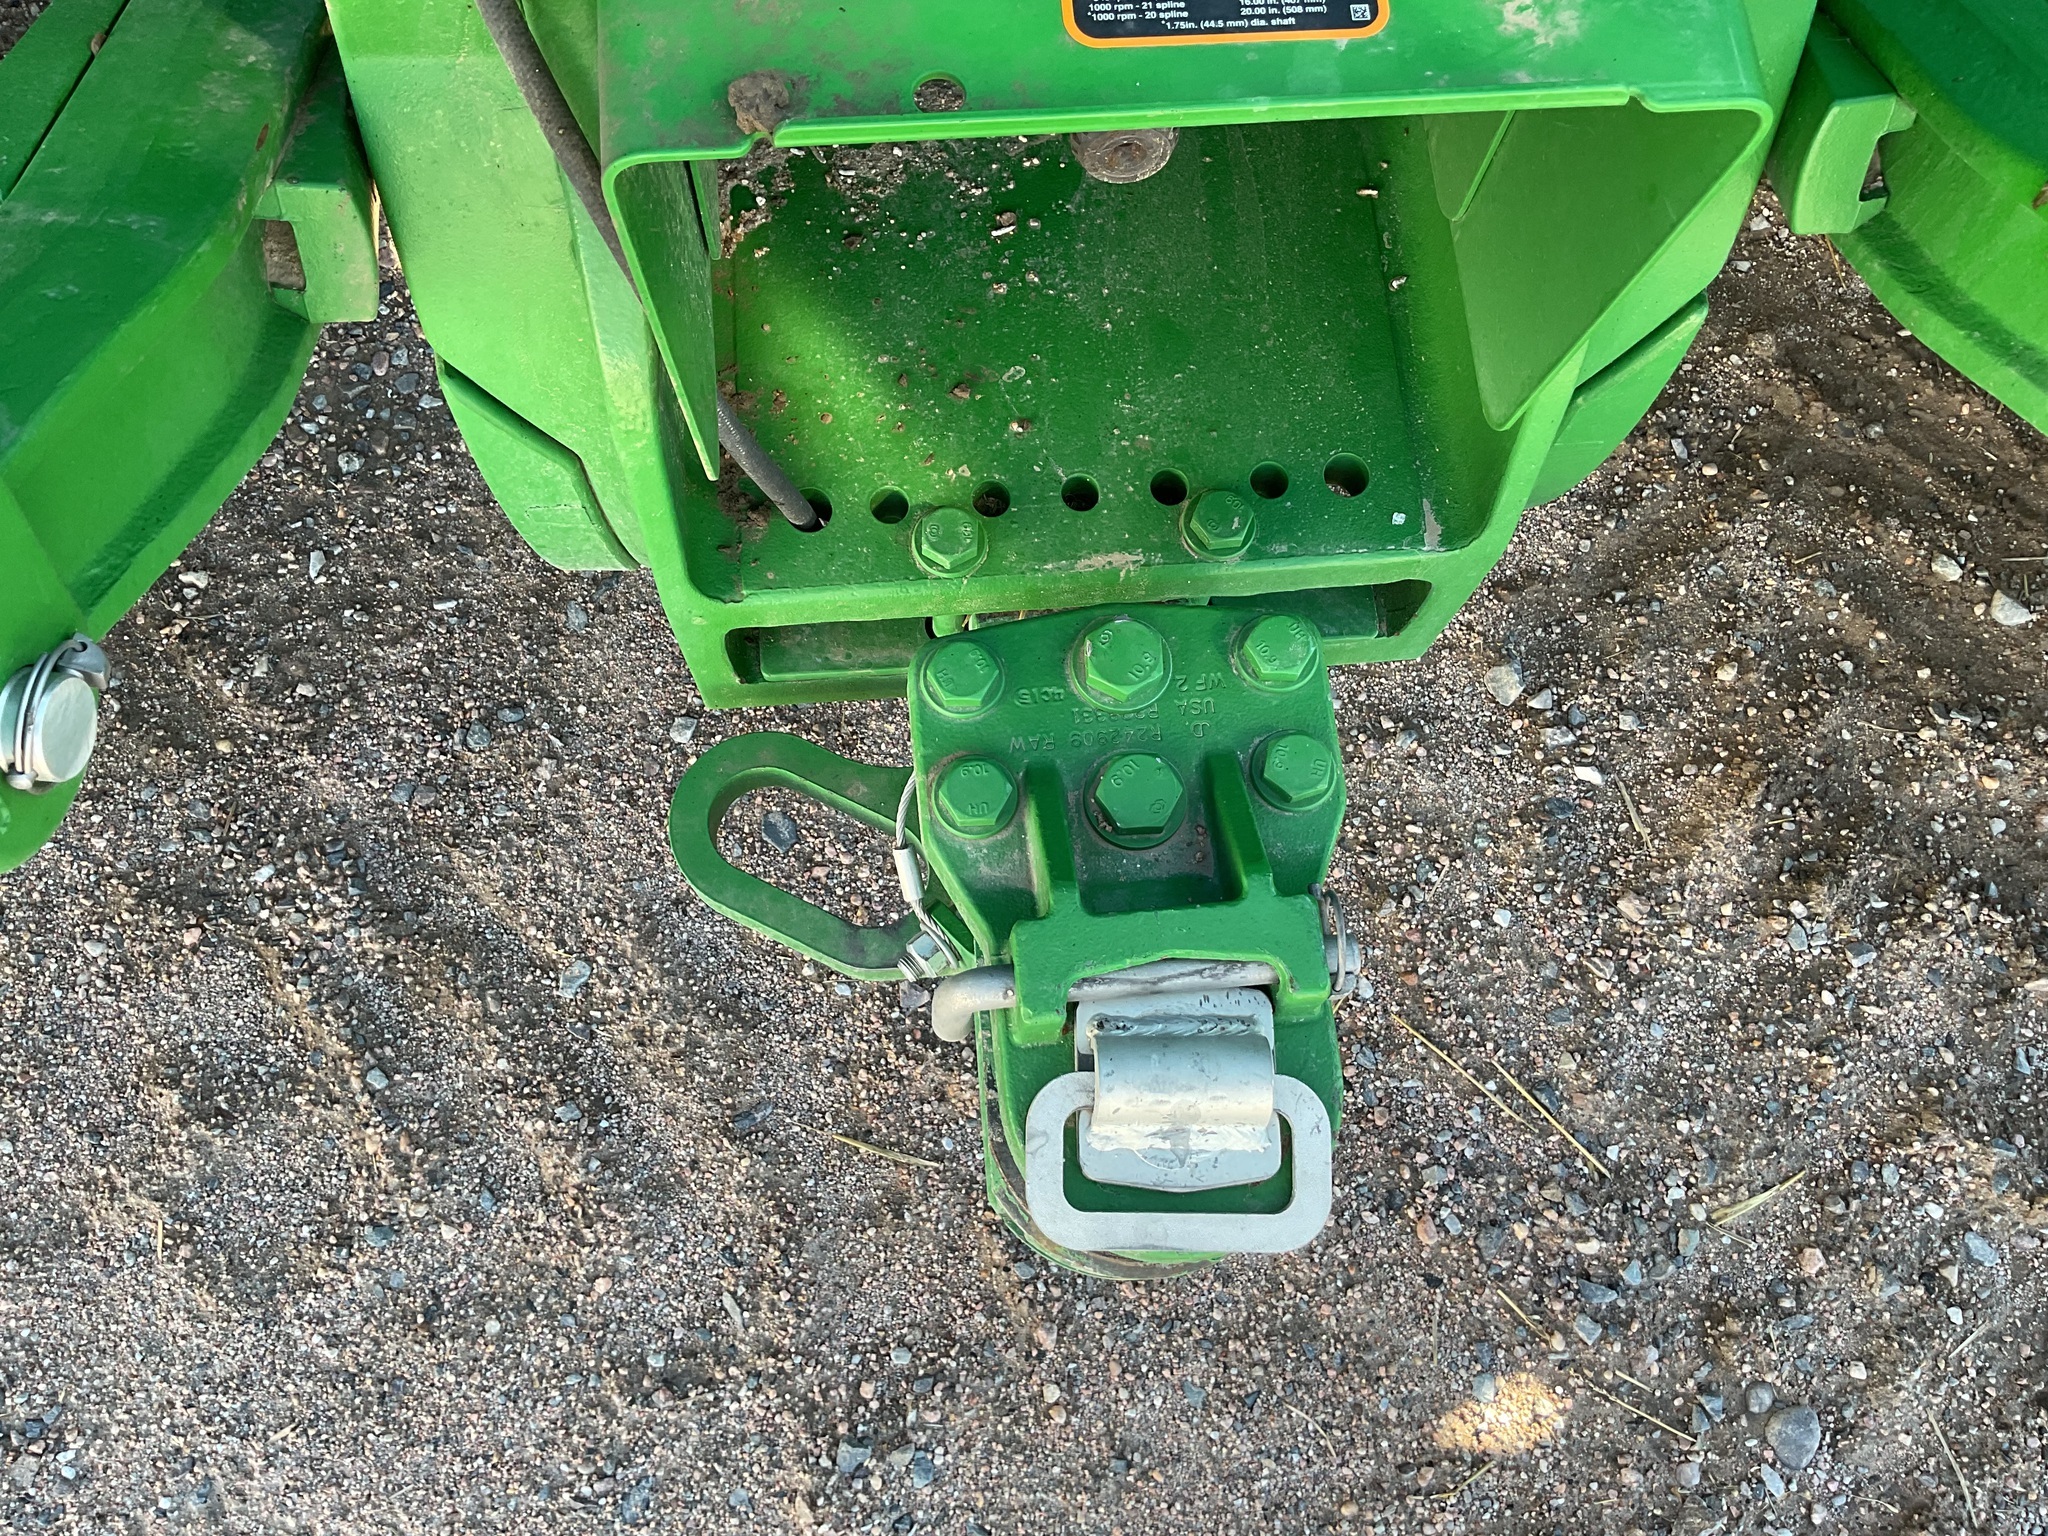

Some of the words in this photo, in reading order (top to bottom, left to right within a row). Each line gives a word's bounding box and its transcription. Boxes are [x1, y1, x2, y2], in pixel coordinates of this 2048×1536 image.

[1088, 3, 1111, 12] 1000
[1114, 4, 1134, 12] rpm
[1141, 2, 1153, 10] 21
[1156, 1, 1186, 11] spline
[1240, 7, 1266, 16] 20.00
[1268, 6, 1281, 14] in.
[1282, 5, 1303, 15] (508
[1305, 5, 1327, 14] mm)
[1117, 13, 1136, 22] rpm
[1144, 11, 1156, 19] 20
[1159, 10, 1189, 20] spline
[1200, 20, 1224, 29] (44.5
[1226, 18, 1248, 28] mm)
[1250, 18, 1268, 27] dia.
[1271, 16, 1296, 26] shaft
[1175, 674, 1188, 692] 2
[1195, 672, 1227, 692] WF
[1174, 697, 1215, 716] USA
[1009, 732, 1056, 753] RAW
[960, 763, 989, 778] 10.9
[1110, 758, 1141, 788] 10.9
[968, 801, 989, 816] UH
